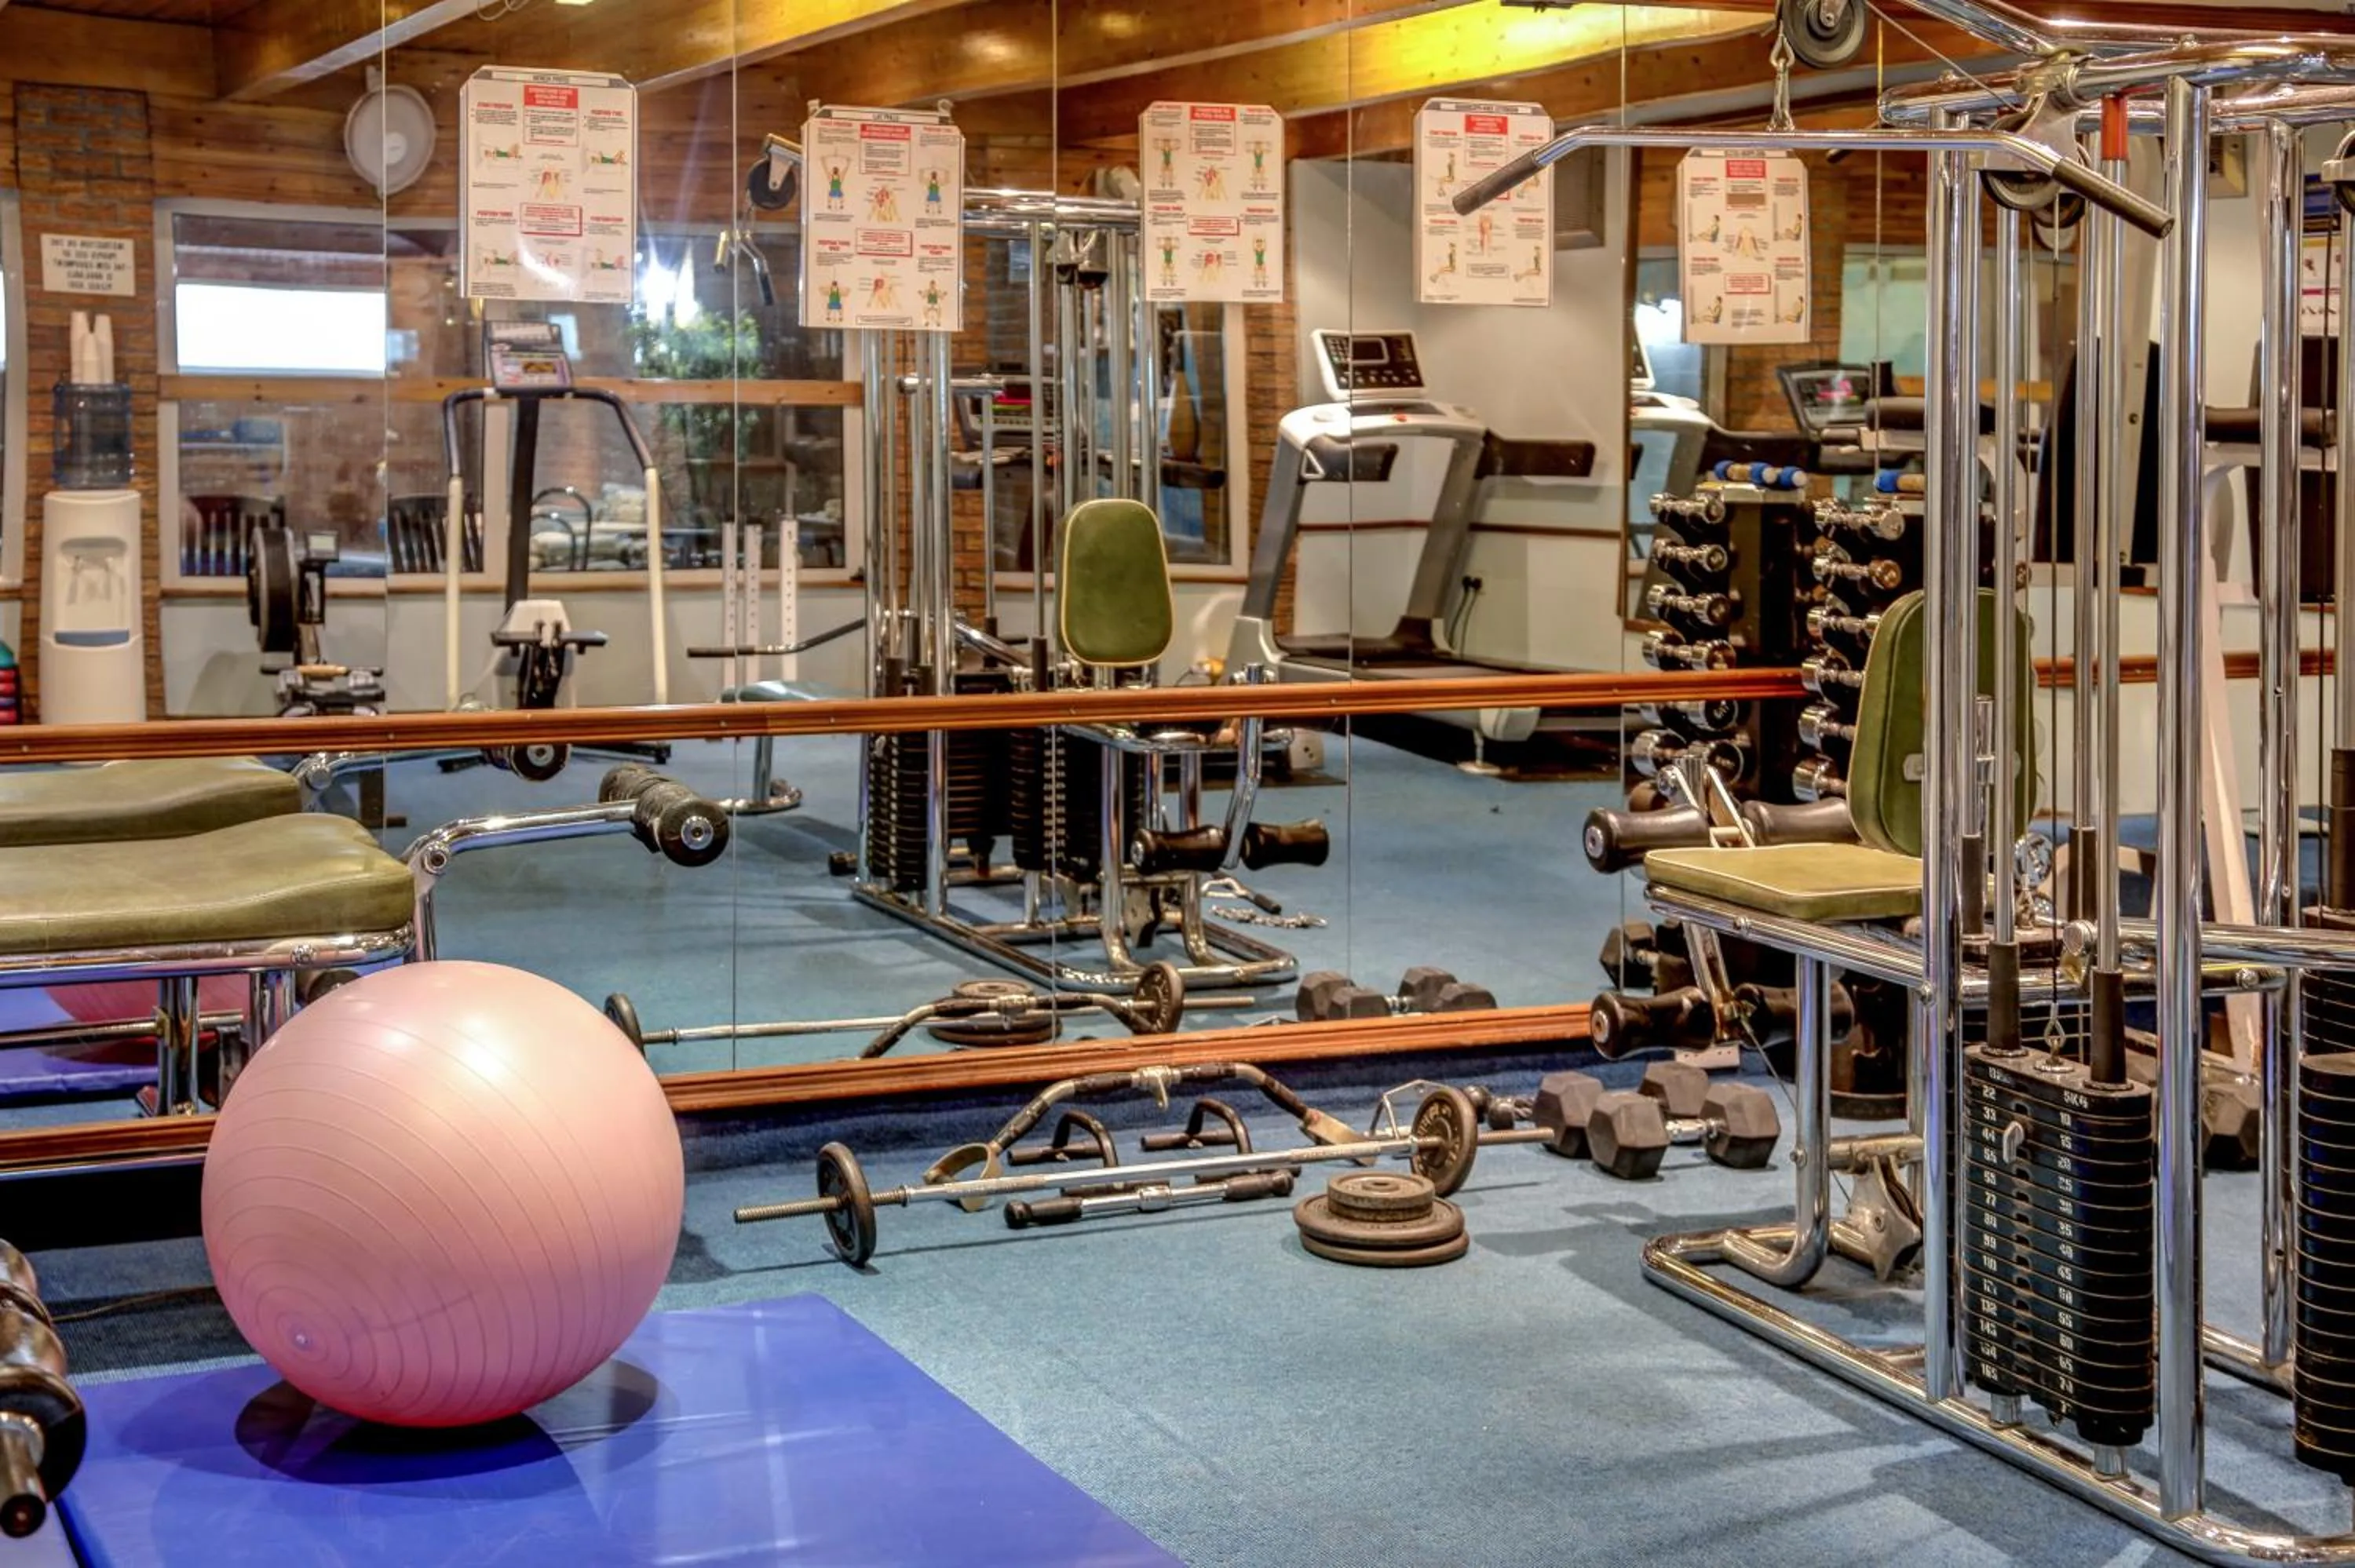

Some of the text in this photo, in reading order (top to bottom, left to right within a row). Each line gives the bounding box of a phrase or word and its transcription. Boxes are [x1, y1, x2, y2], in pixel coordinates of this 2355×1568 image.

[1982, 1085, 1996, 1100] 22
[1983, 1106, 1996, 1121] 33
[2060, 1112, 2072, 1127] 10
[1984, 1191, 1996, 1208] 77
[1983, 1255, 1997, 1271] 110
[1981, 1362, 1998, 1381] 165
